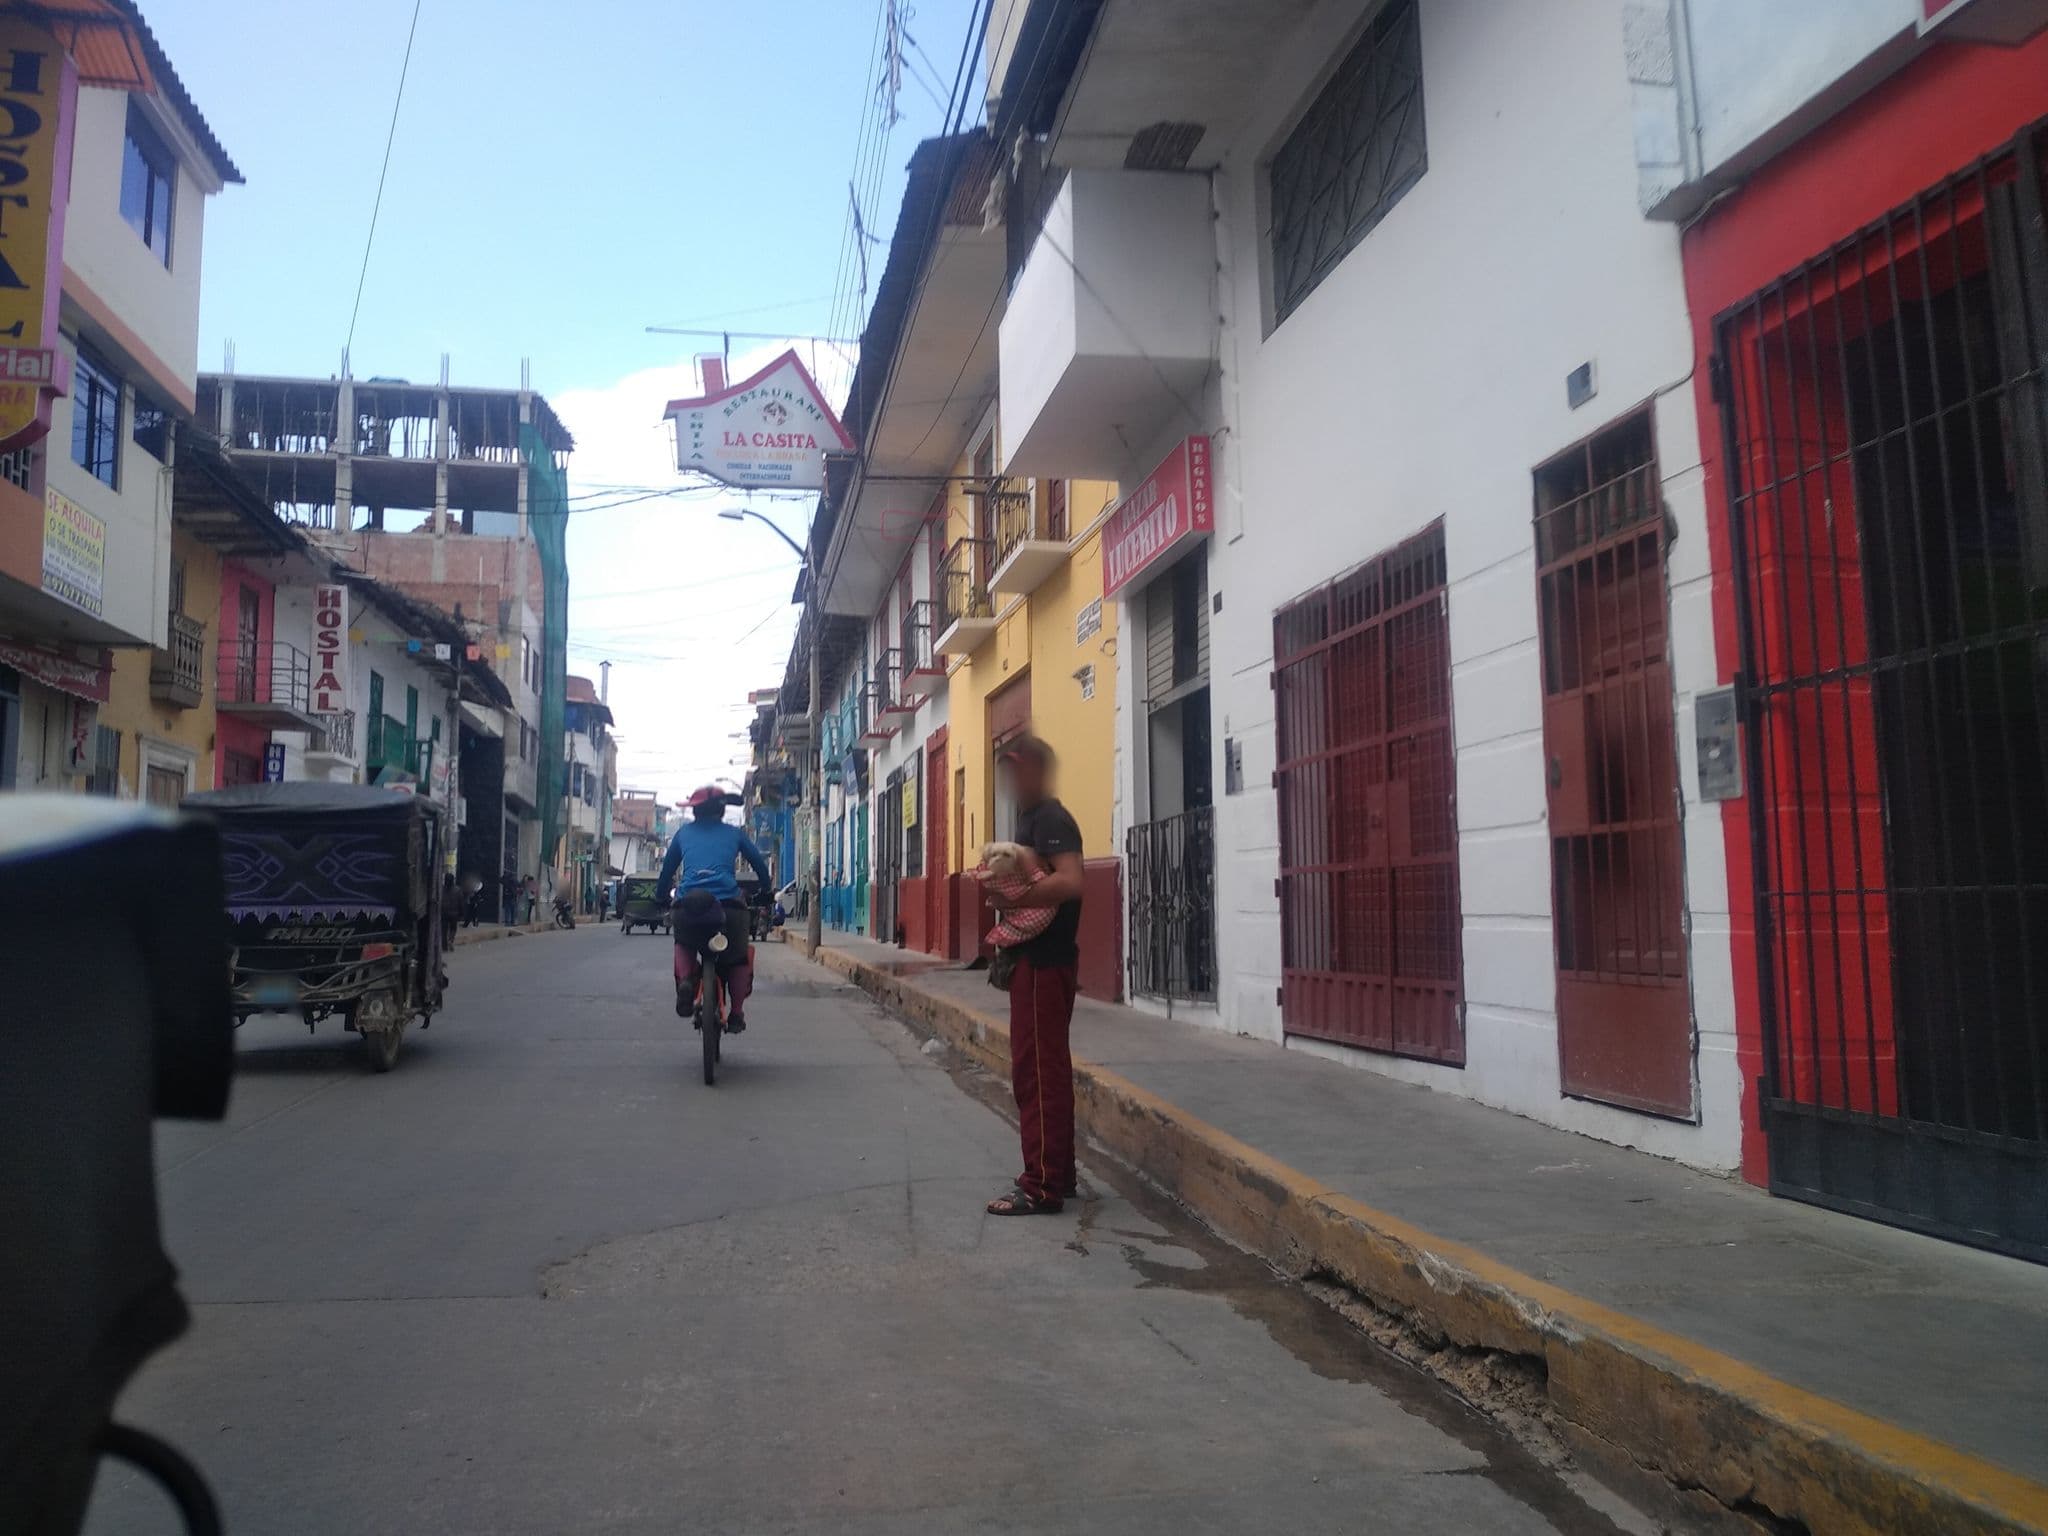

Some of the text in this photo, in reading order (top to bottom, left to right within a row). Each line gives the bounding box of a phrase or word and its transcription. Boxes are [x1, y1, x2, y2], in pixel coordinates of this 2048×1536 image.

[723, 431, 818, 449] LA CASITA
[49, 491, 102, 540] SE ALQUILA
[1192, 443, 1206, 525] REGALOS
[1108, 493, 1178, 588] LUCERITO
[314, 590, 342, 711] HOSTAL
